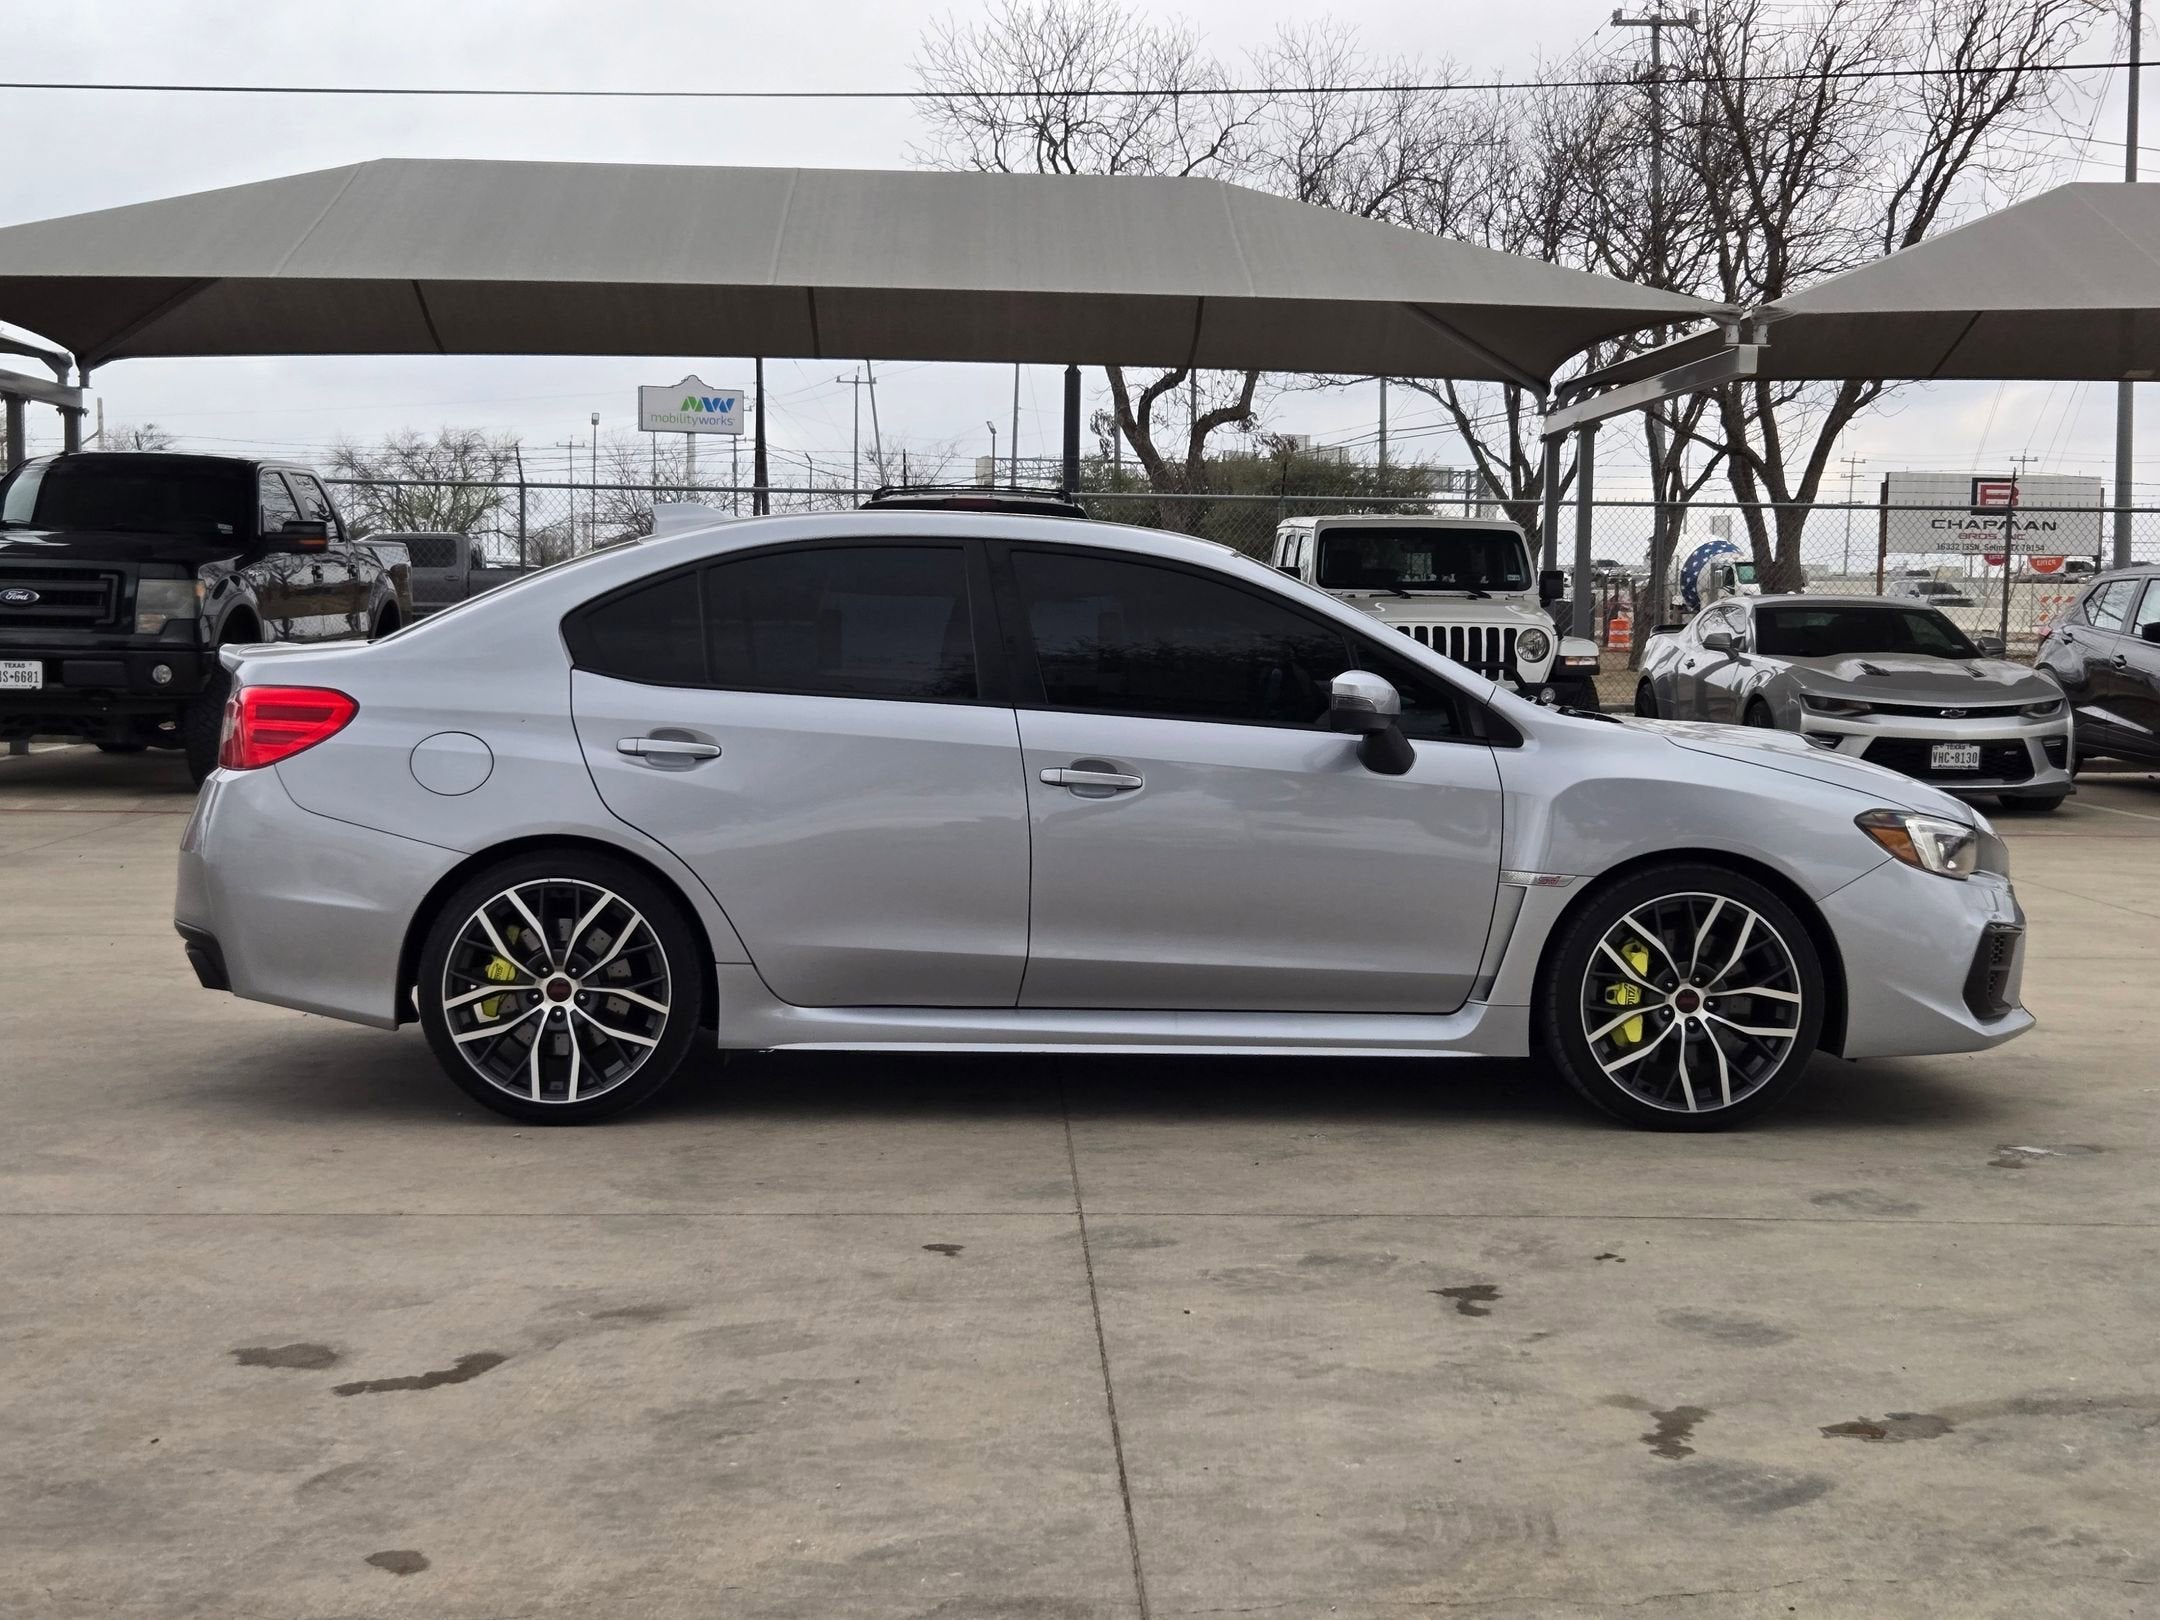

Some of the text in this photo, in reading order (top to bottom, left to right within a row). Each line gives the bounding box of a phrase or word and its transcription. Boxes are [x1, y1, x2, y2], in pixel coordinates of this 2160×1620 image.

[650, 412, 734, 427] mobilityworks
[1931, 519, 2057, 531] CHAPMAN
[6, 591, 29, 600] Ford
